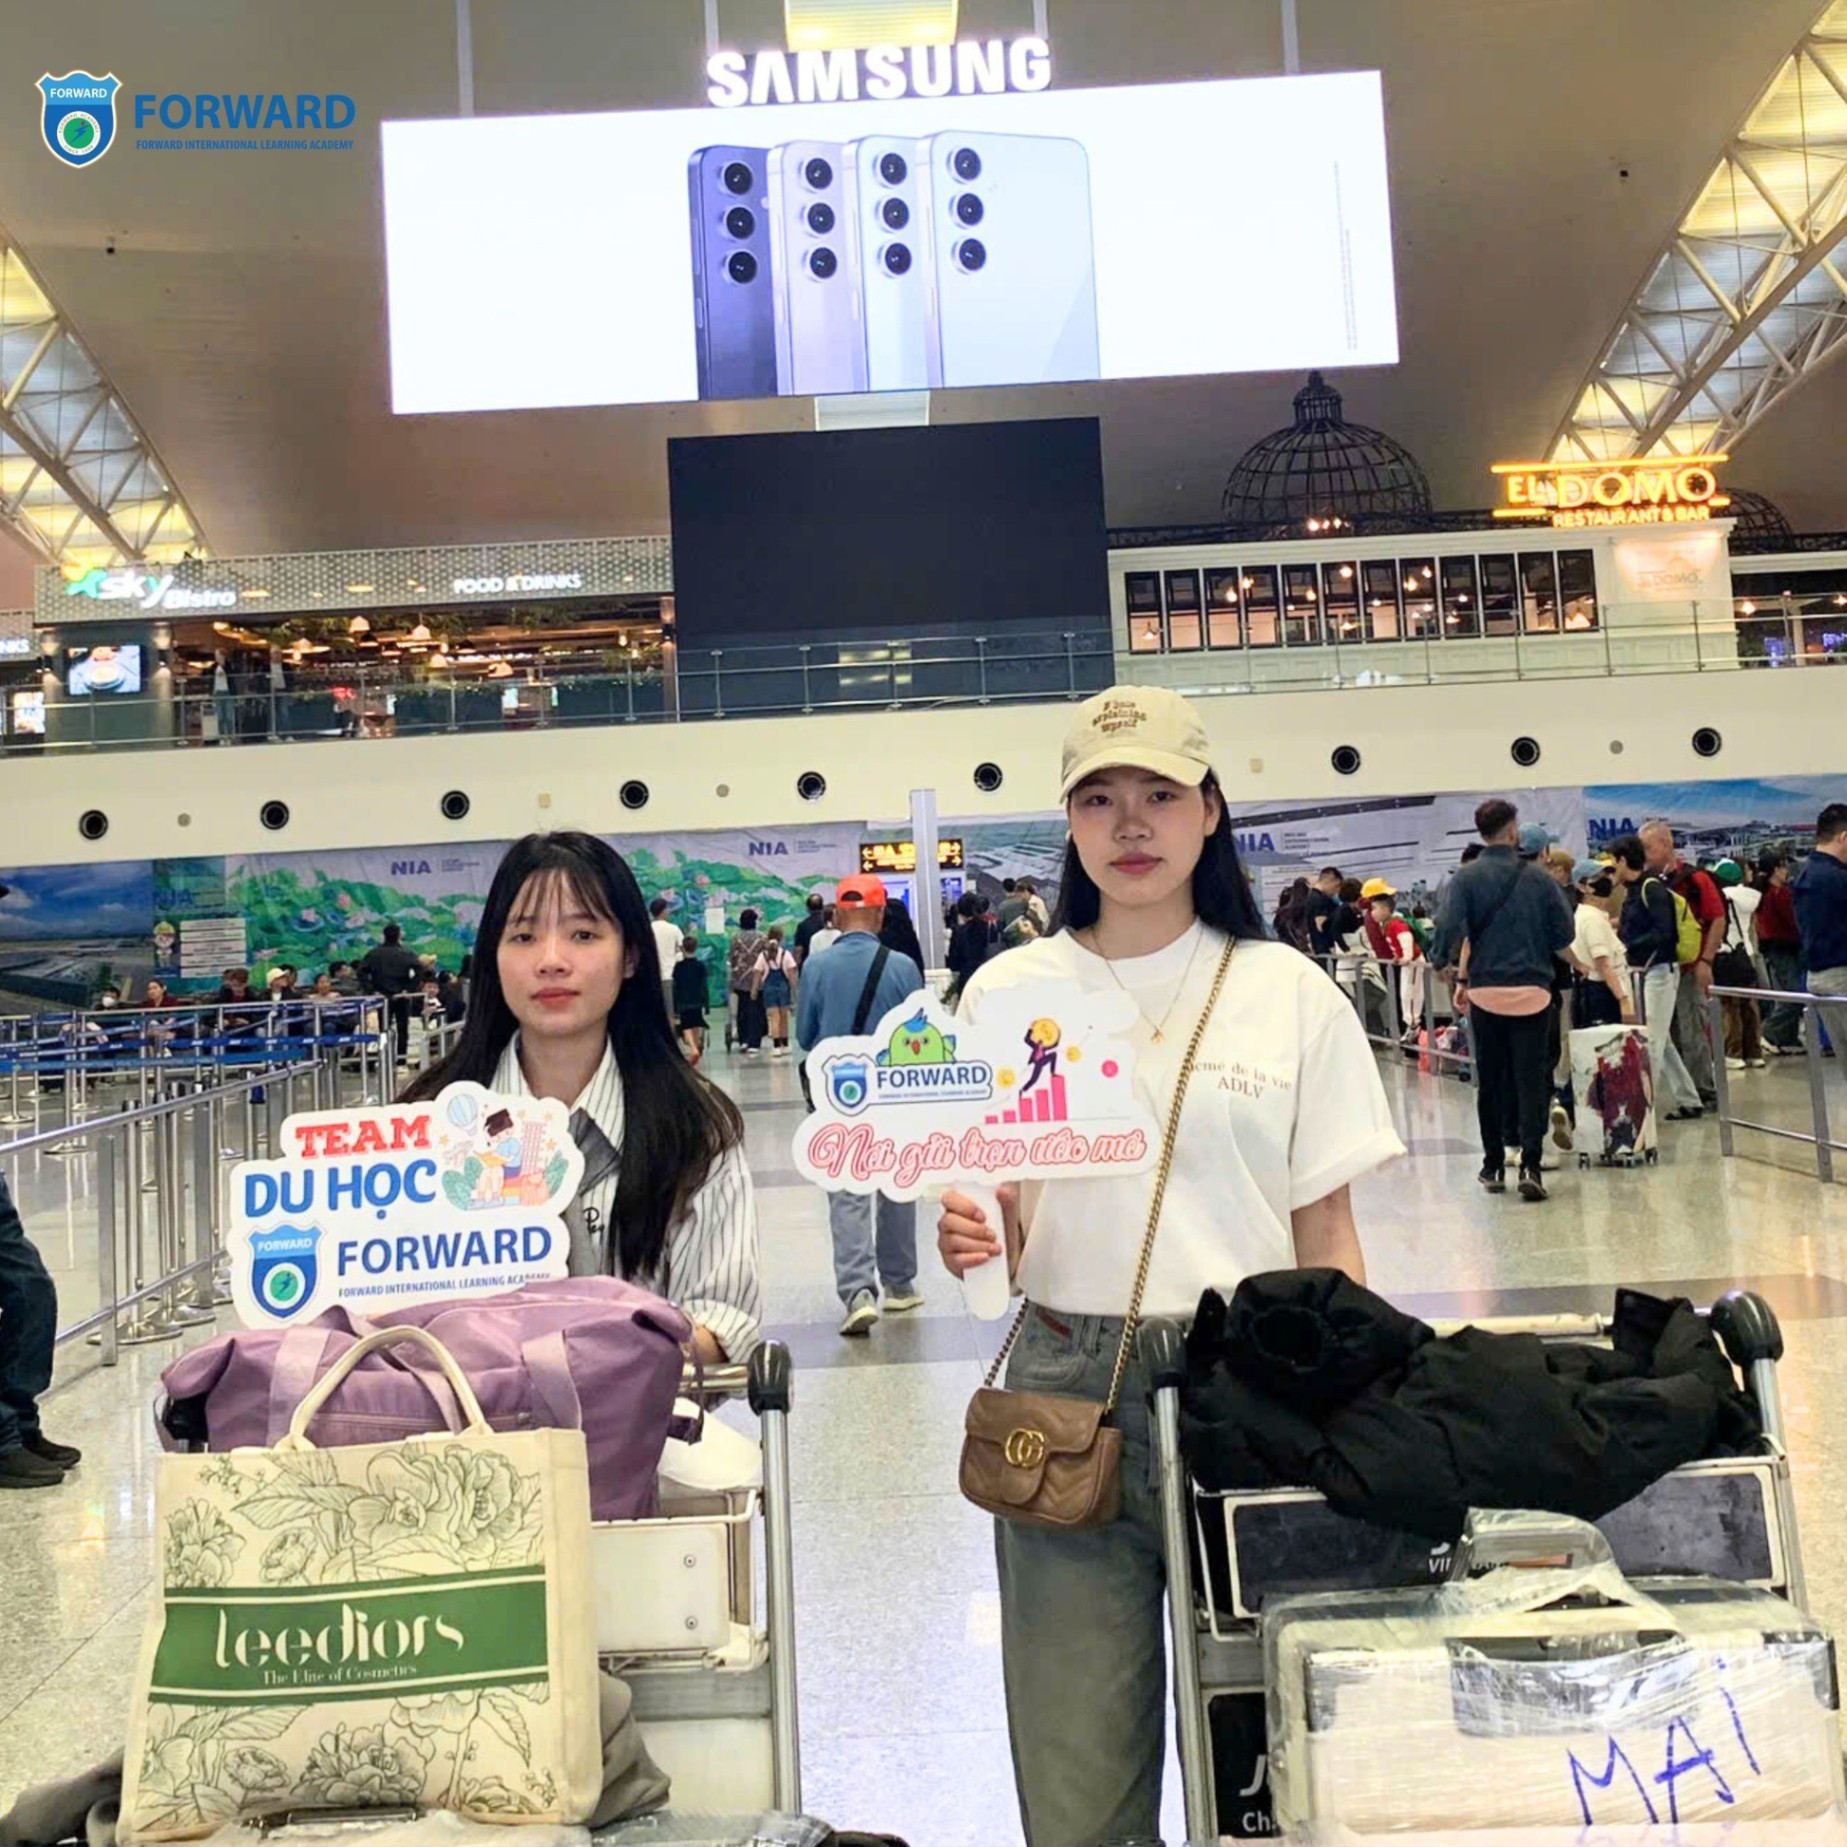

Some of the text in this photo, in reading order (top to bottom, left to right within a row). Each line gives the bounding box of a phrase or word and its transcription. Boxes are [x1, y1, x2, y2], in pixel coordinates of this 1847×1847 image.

[706, 36, 1051, 107] SAMSUNG
[1556, 466, 1717, 508] DOMO
[1552, 509, 1662, 528] RESTAURANT
[1675, 506, 1711, 521] BAR
[453, 579, 501, 594] FOOD
[522, 573, 583, 591] DRINKS
[164, 589, 237, 609] Bistro
[749, 842, 788, 855] NIA
[391, 861, 432, 875] NIA
[876, 1066, 988, 1089] FORWARD
[1217, 1076, 1264, 1100] ADLV
[295, 1115, 433, 1160] TEAM
[244, 1158, 437, 1220] DU HỌC
[257, 1237, 313, 1252] FORWARD
[337, 1226, 551, 1277] FORWARD
[338, 1286, 384, 1299] FORWARD
[385, 1281, 457, 1295] INTERNATIONAL
[459, 1275, 505, 1290] LEARNING
[264, 1670, 288, 1685] The
[328, 1666, 343, 1682] of
[346, 1664, 417, 1680] Cosmetics
